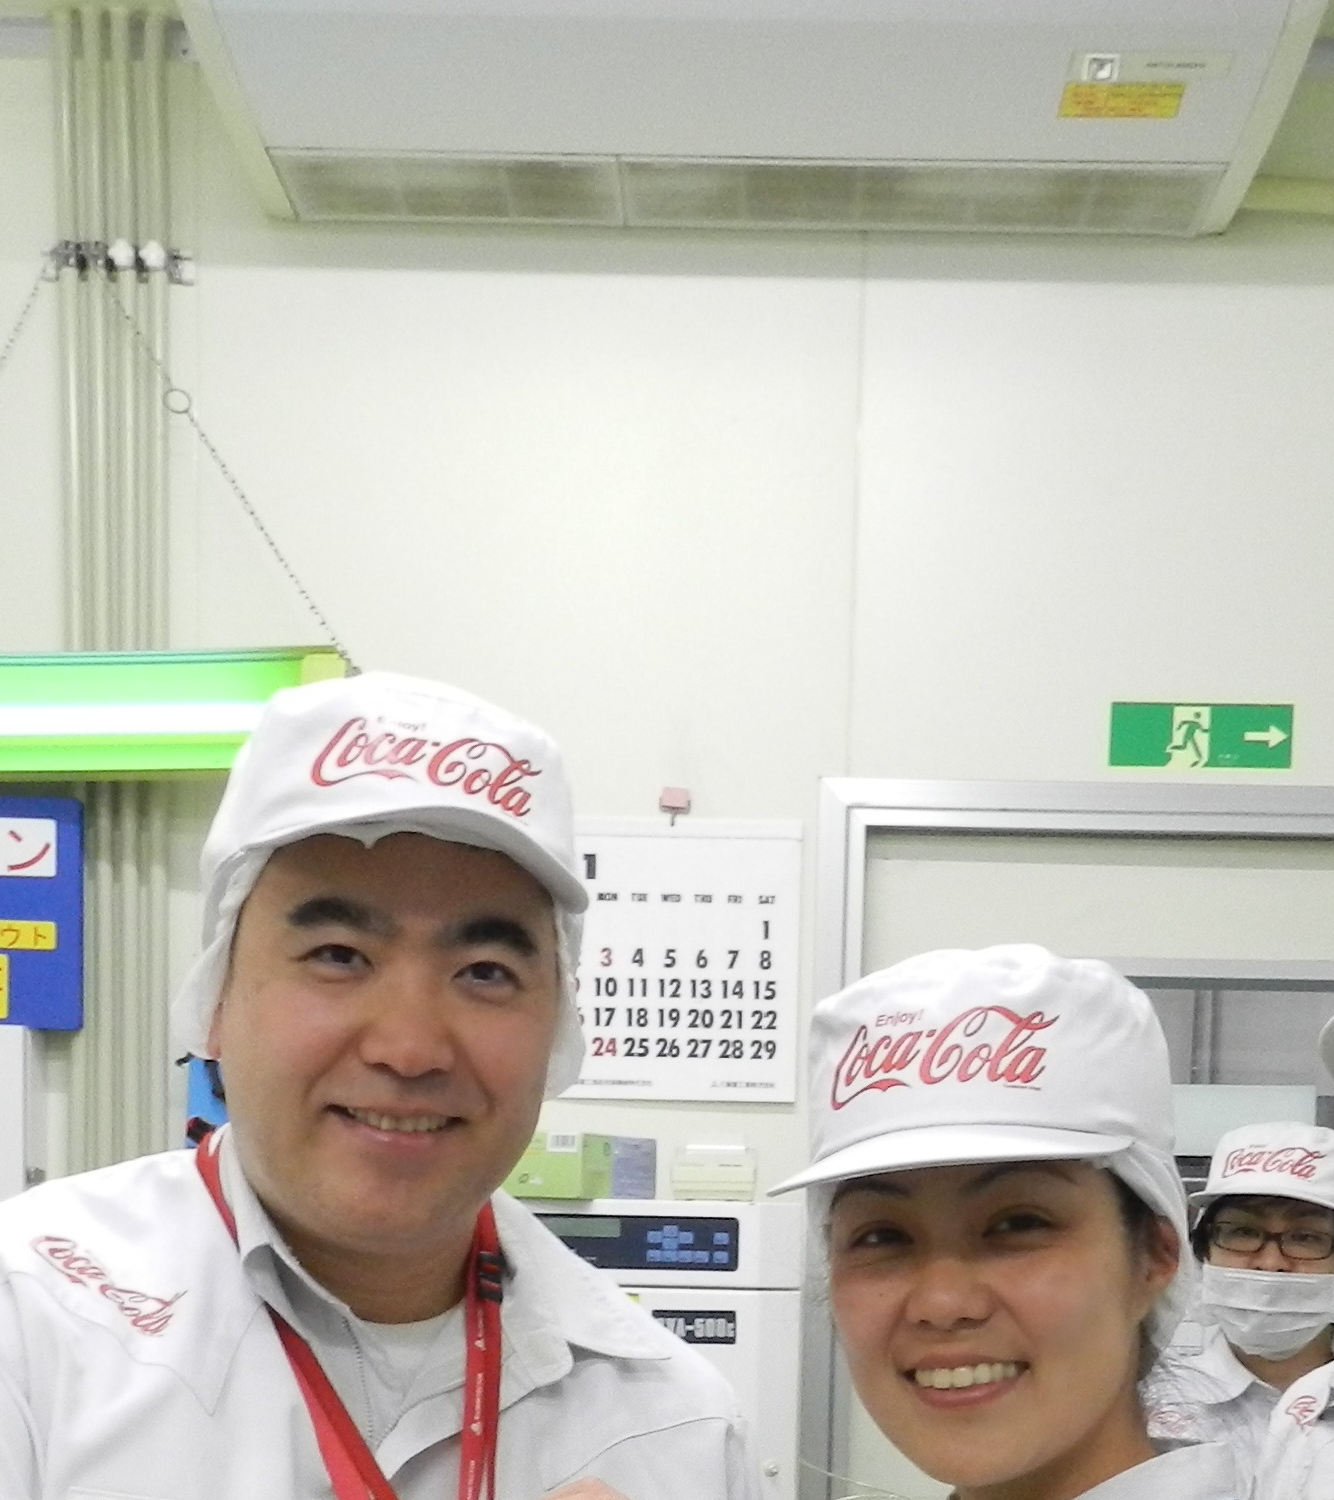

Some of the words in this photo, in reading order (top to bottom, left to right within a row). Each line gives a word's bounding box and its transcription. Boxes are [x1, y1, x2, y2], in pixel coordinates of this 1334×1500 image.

[310, 716, 543, 817] Coca-Cola
[762, 920, 770, 940] 1
[601, 948, 613, 967] 3
[632, 948, 644, 967] 4
[663, 949, 676, 968] 5
[696, 949, 708, 968] 6
[727, 950, 739, 969] 7
[759, 950, 772, 970] 8
[594, 977, 618, 997] 10
[628, 978, 648, 997] 11
[658, 978, 682, 998] 12
[690, 979, 713, 998] 13
[721, 980, 744, 999] 14
[753, 980, 777, 1000] 15
[594, 1007, 616, 1027] 17
[626, 1008, 649, 1027] 18
[657, 1009, 681, 1028] 19
[687, 1009, 714, 1029] 20
[720, 1010, 743, 1029] 21
[750, 1010, 777, 1030] 22
[874, 1008, 925, 1028] Enjoy!
[591, 1037, 618, 1057] 24
[623, 1038, 649, 1058] 25
[655, 1039, 681, 1058] 26
[686, 1039, 713, 1059] 27
[718, 1040, 744, 1059] 28
[749, 1040, 777, 1060] 29
[831, 1004, 1061, 1111] Coca-Cola
[1221, 1146, 1328, 1179] Coca-Cola
[30, 1234, 188, 1337] Coca-Cola
